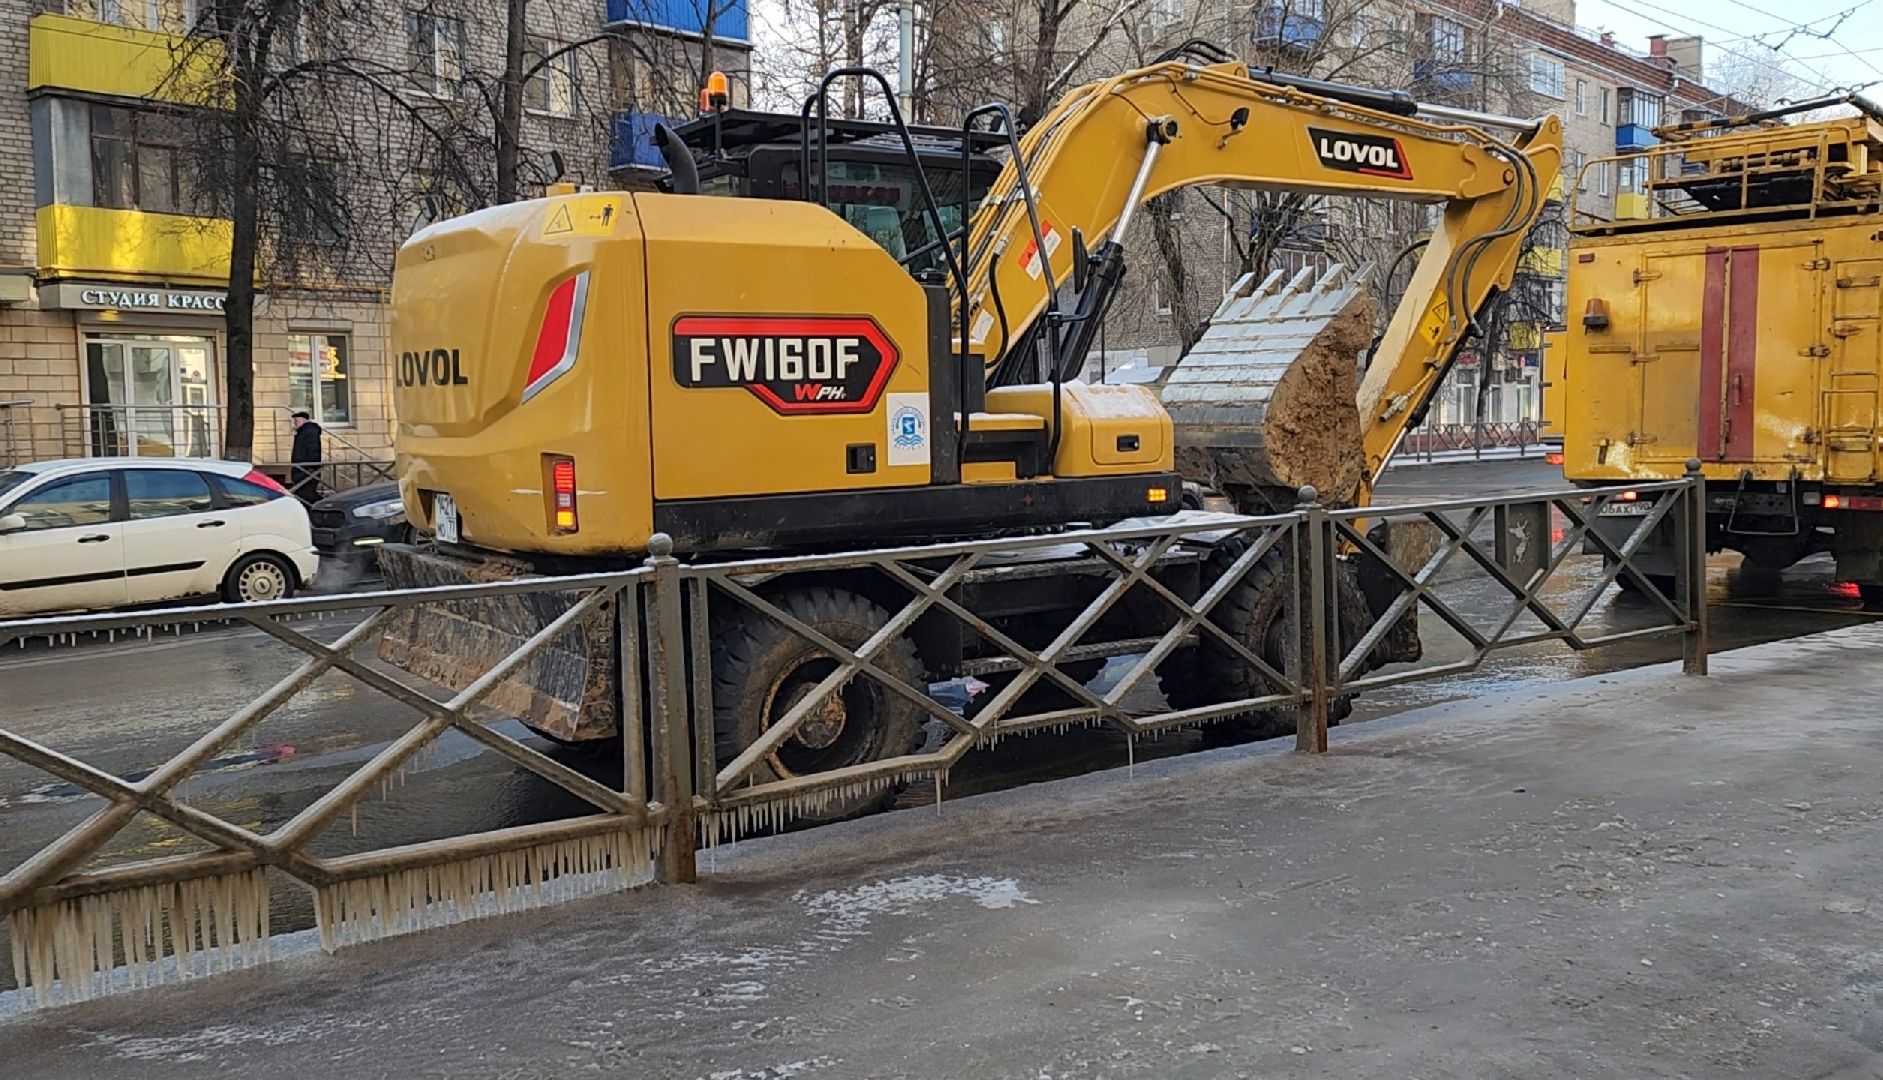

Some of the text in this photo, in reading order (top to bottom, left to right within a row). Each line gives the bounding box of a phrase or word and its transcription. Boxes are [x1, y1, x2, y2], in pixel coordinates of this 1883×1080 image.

[1320, 137, 1399, 169] LOVOL
[81, 289, 226, 310] СТУДИЯ КРАСО
[395, 348, 468, 388] LOVOL
[690, 337, 859, 382] FW160F
